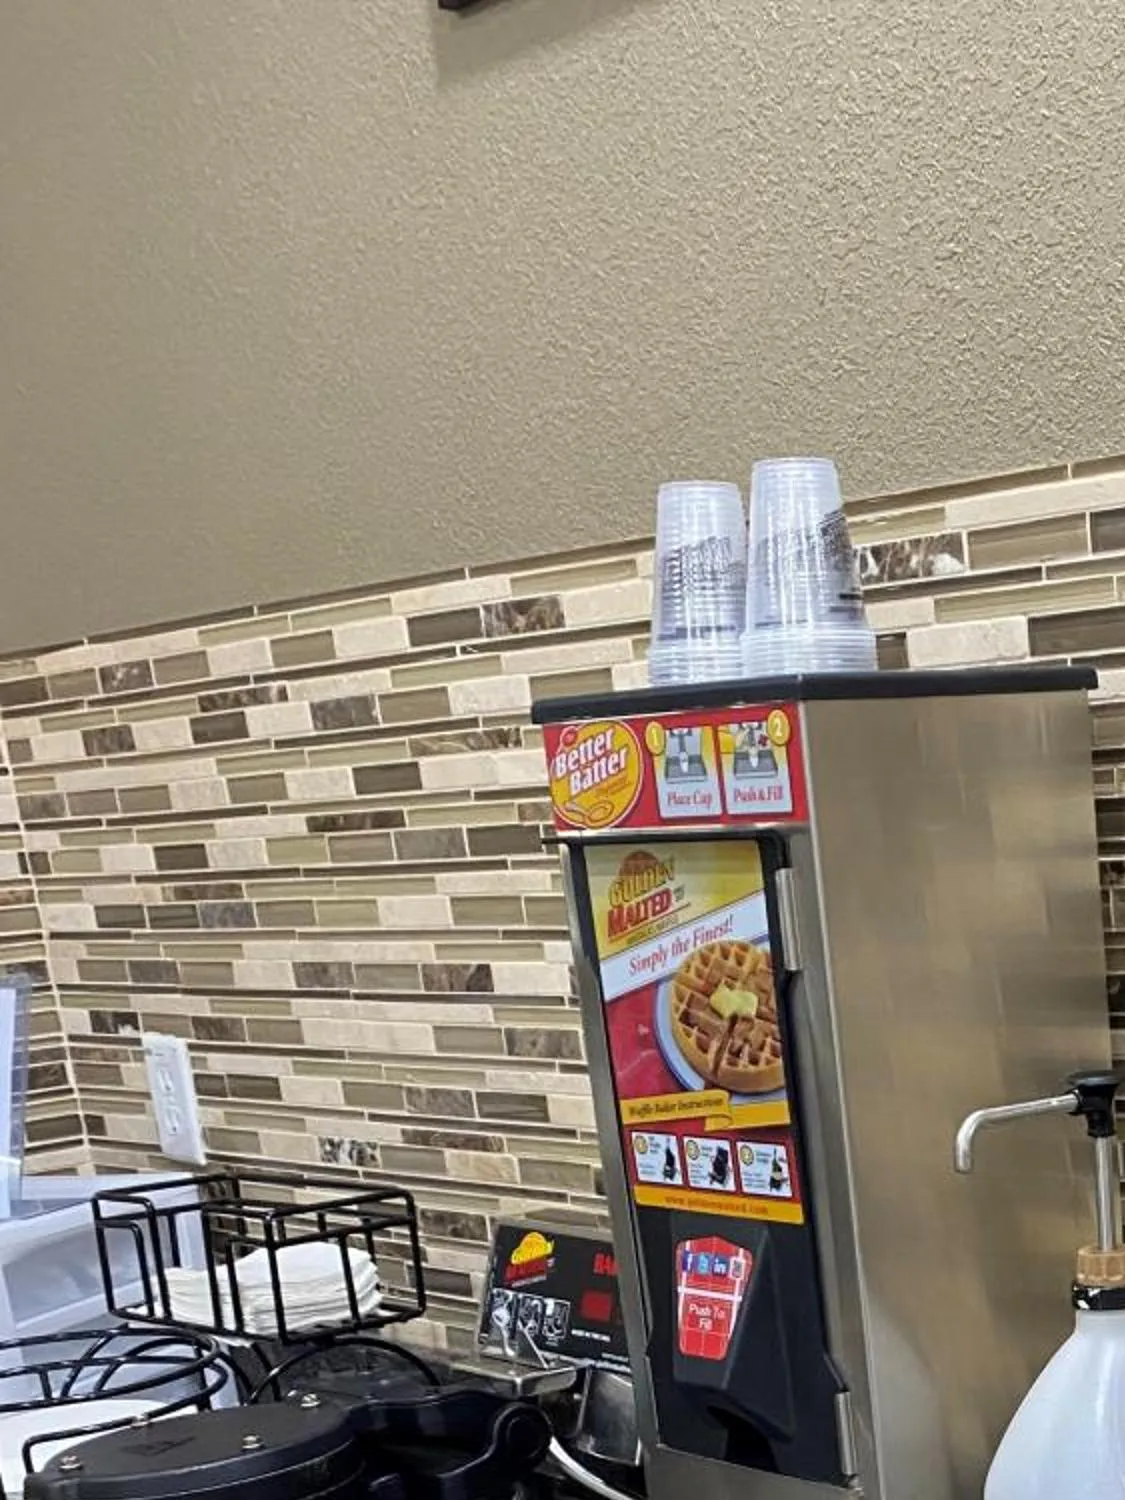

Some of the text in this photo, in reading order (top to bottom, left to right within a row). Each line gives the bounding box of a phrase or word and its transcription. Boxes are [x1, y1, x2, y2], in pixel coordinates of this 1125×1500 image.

[555, 727, 614, 778] Better
[570, 746, 628, 796] Batter
[607, 887, 673, 938] MALTED
[629, 943, 668, 976] Simply
[671, 936, 691, 955] the
[693, 914, 734, 948] Finest!
